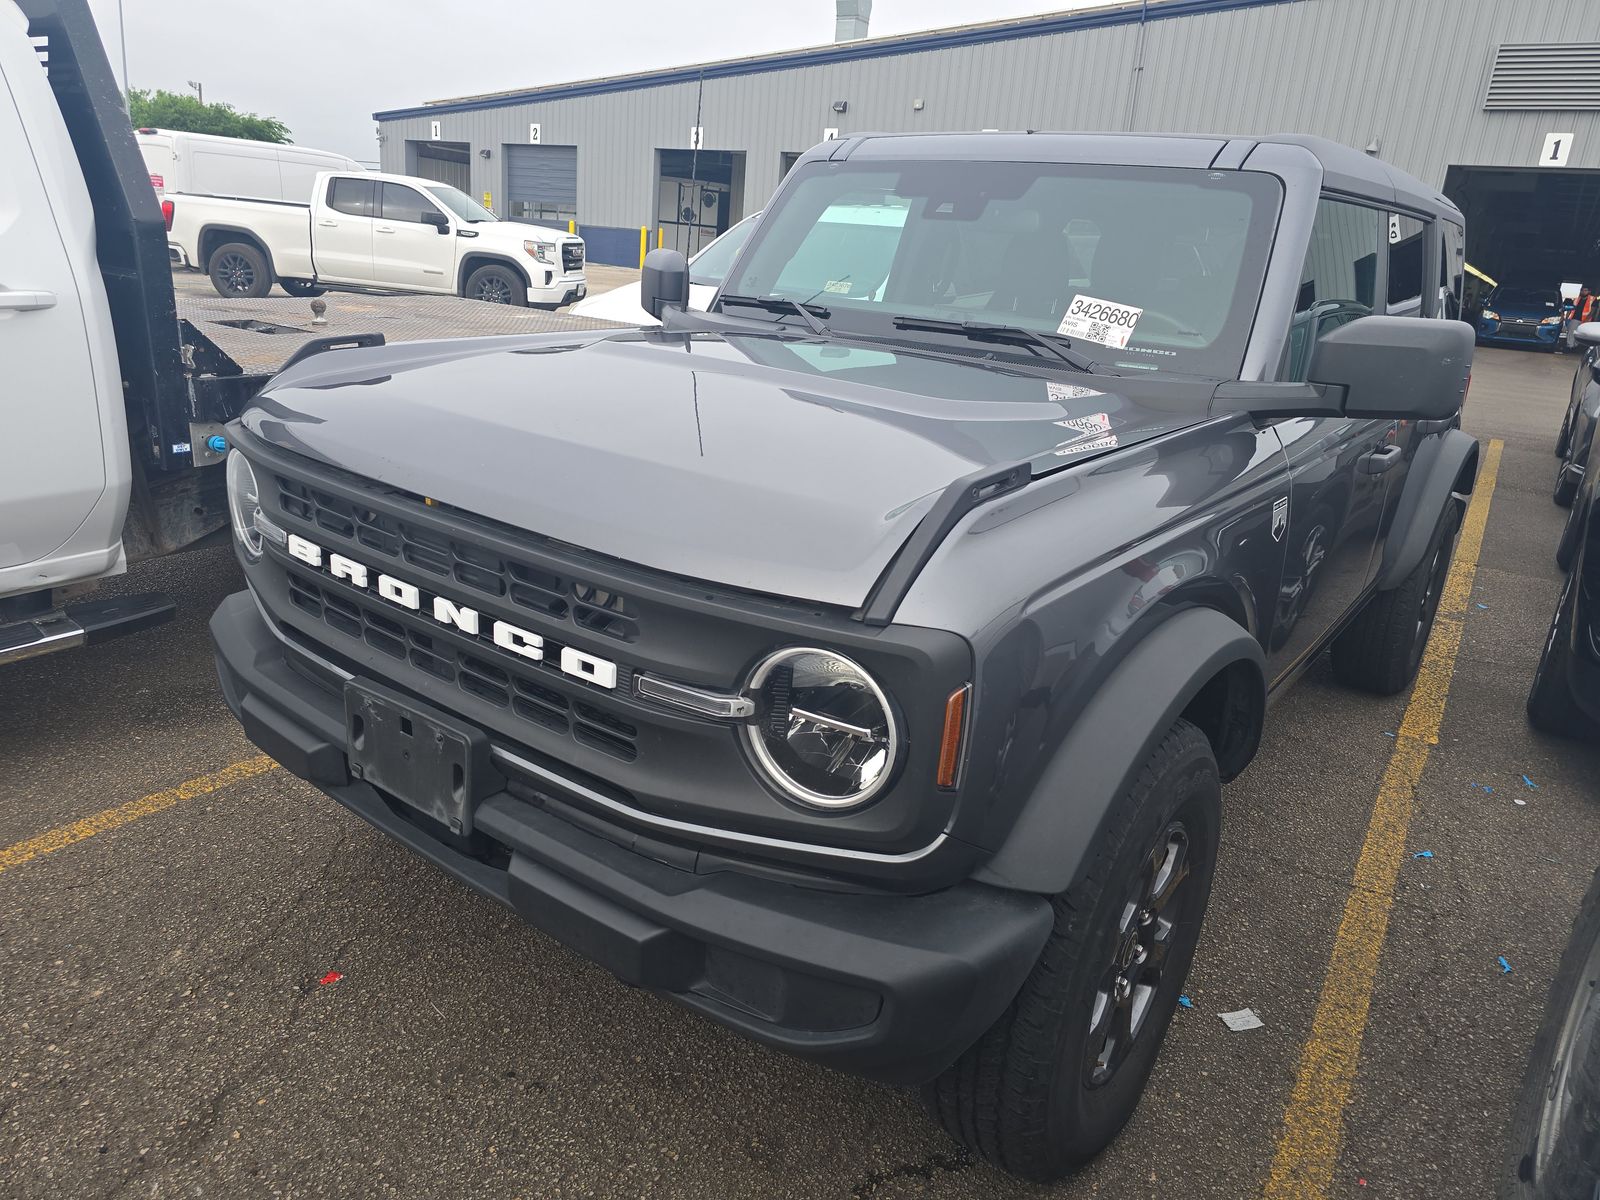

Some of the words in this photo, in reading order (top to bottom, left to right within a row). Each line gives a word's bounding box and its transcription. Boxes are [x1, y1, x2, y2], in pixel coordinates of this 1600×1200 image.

[532, 127, 538, 140] 2
[1549, 139, 1562, 161] 1
[1062, 319, 1078, 328] AVIS
[1071, 299, 1140, 329] 3426680
[288, 533, 617, 689] BRONCO
